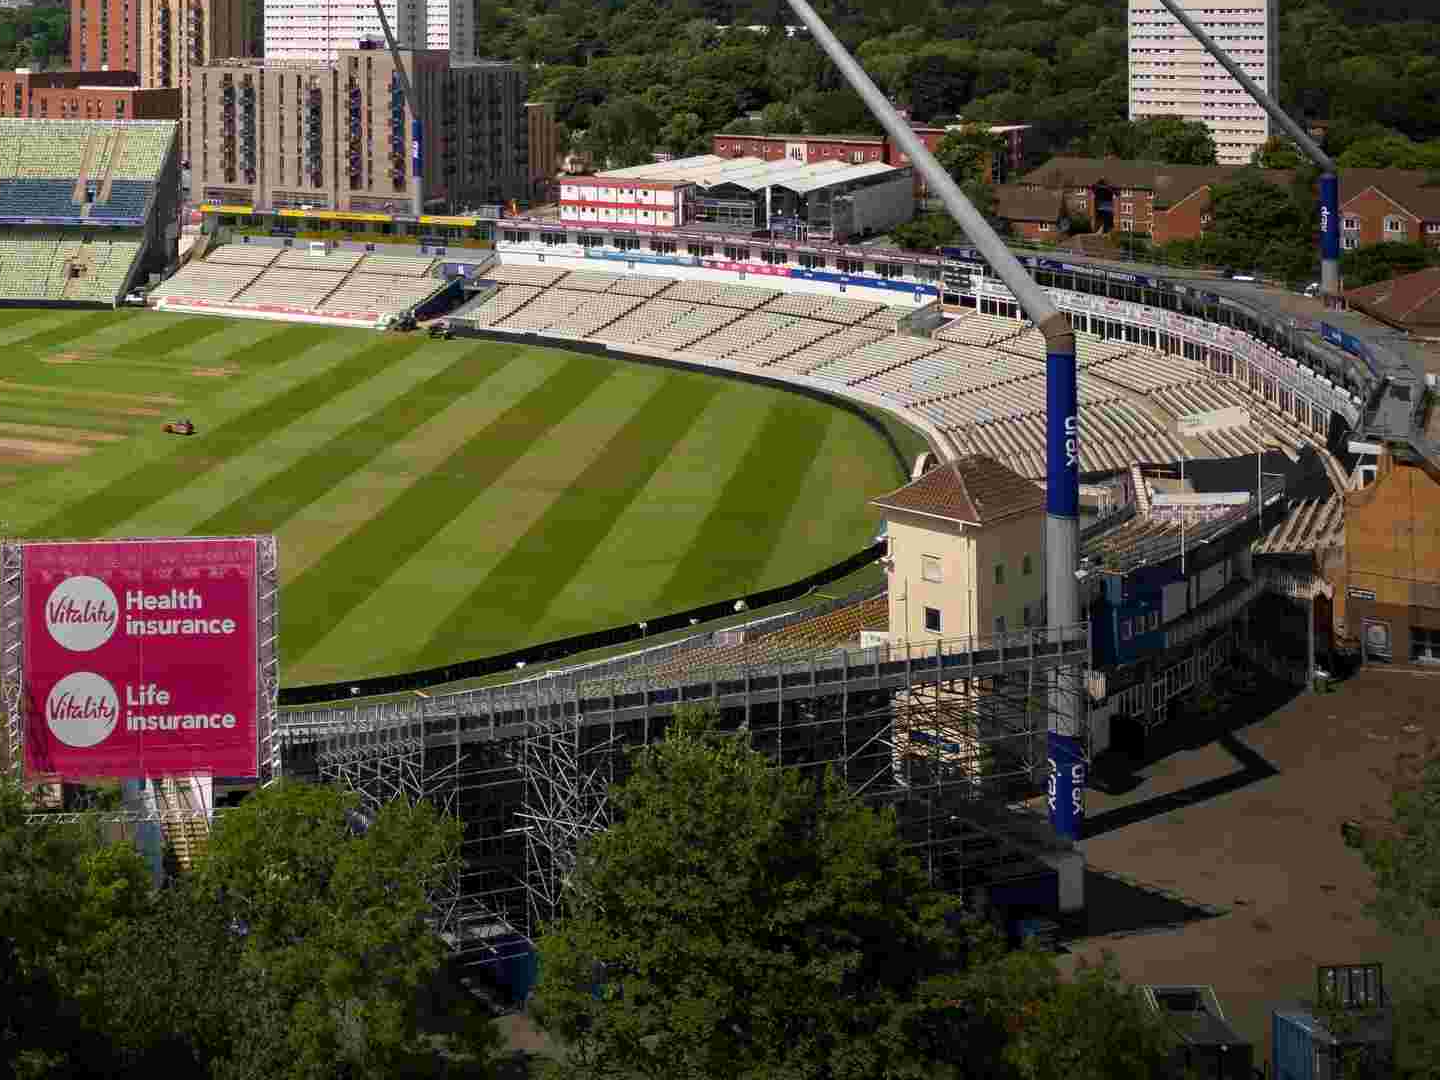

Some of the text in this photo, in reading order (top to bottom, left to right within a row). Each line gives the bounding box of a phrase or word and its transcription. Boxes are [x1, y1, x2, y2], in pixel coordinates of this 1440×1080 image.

[125, 589, 203, 610] Health
[49, 594, 116, 634] Vitality
[125, 615, 237, 636] insurance
[126, 684, 171, 706] Life
[49, 691, 116, 730] Vitality
[126, 711, 237, 731] insurance
